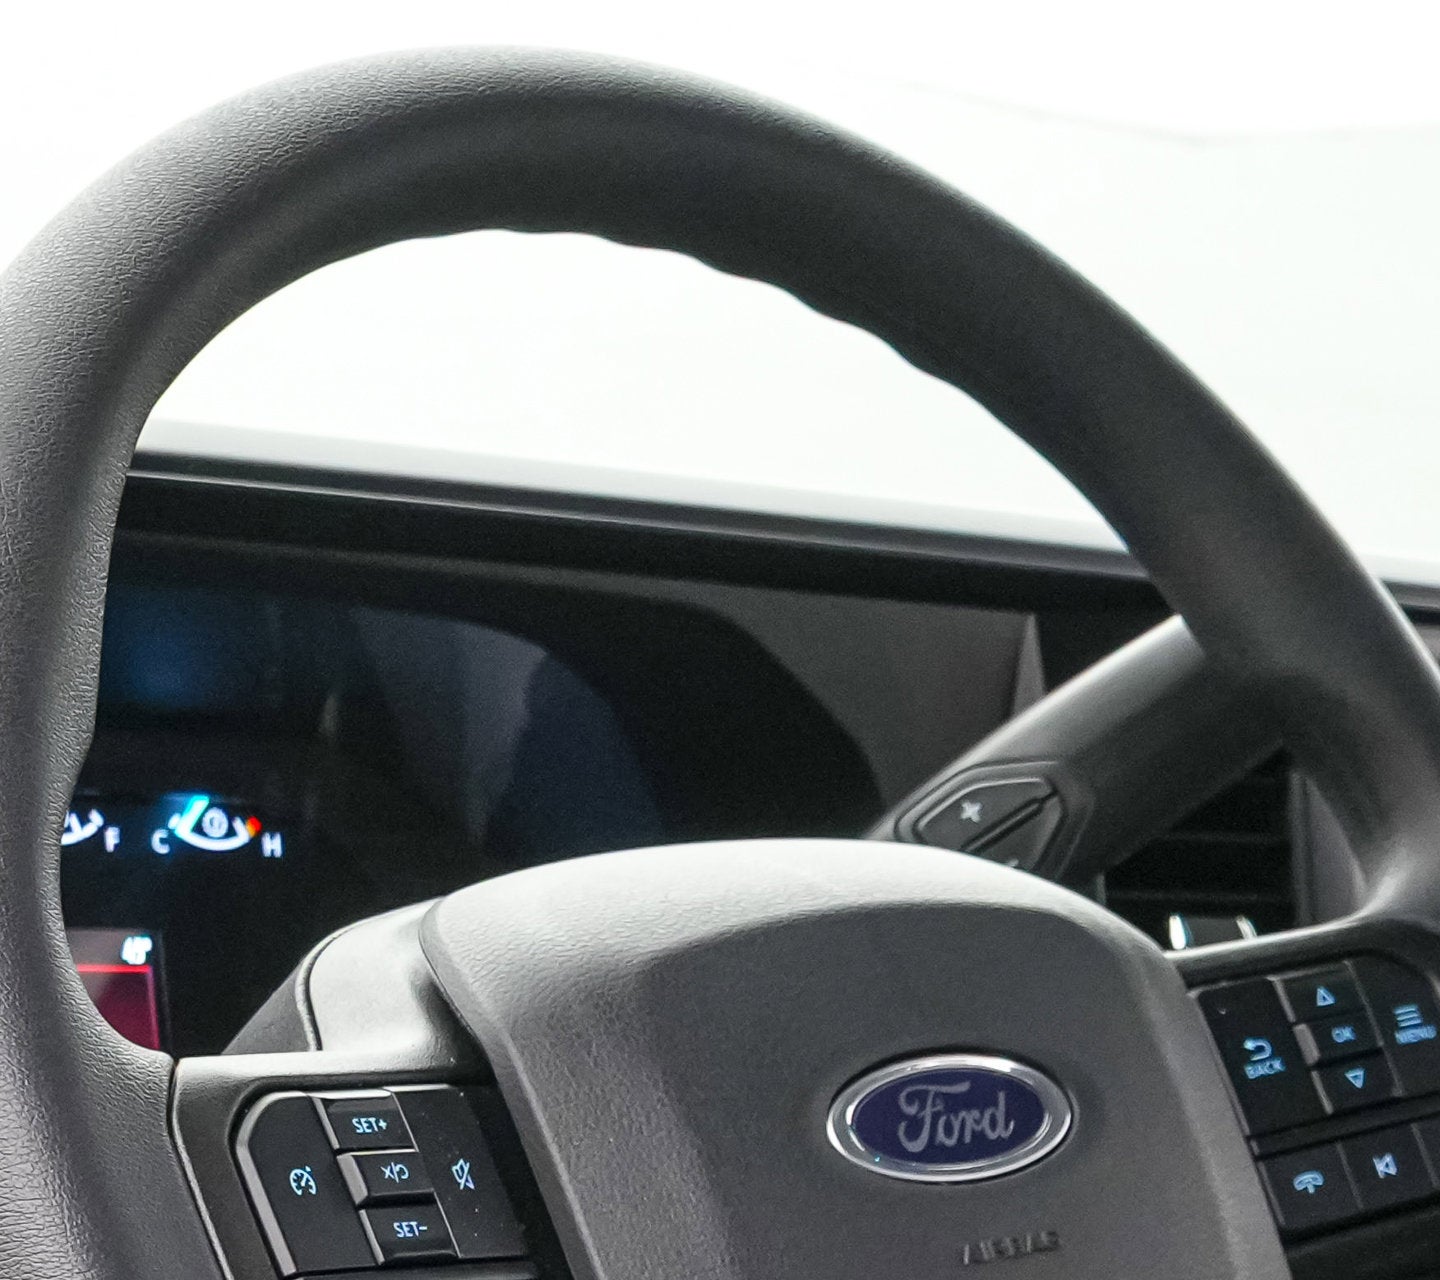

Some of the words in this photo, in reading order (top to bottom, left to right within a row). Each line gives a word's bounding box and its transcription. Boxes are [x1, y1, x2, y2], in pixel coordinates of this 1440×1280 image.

[103, 825, 121, 853] F
[151, 828, 171, 855] C
[261, 831, 283, 858] H
[1244, 1055, 1286, 1080] BACK
[898, 1081, 1015, 1153] Ford
